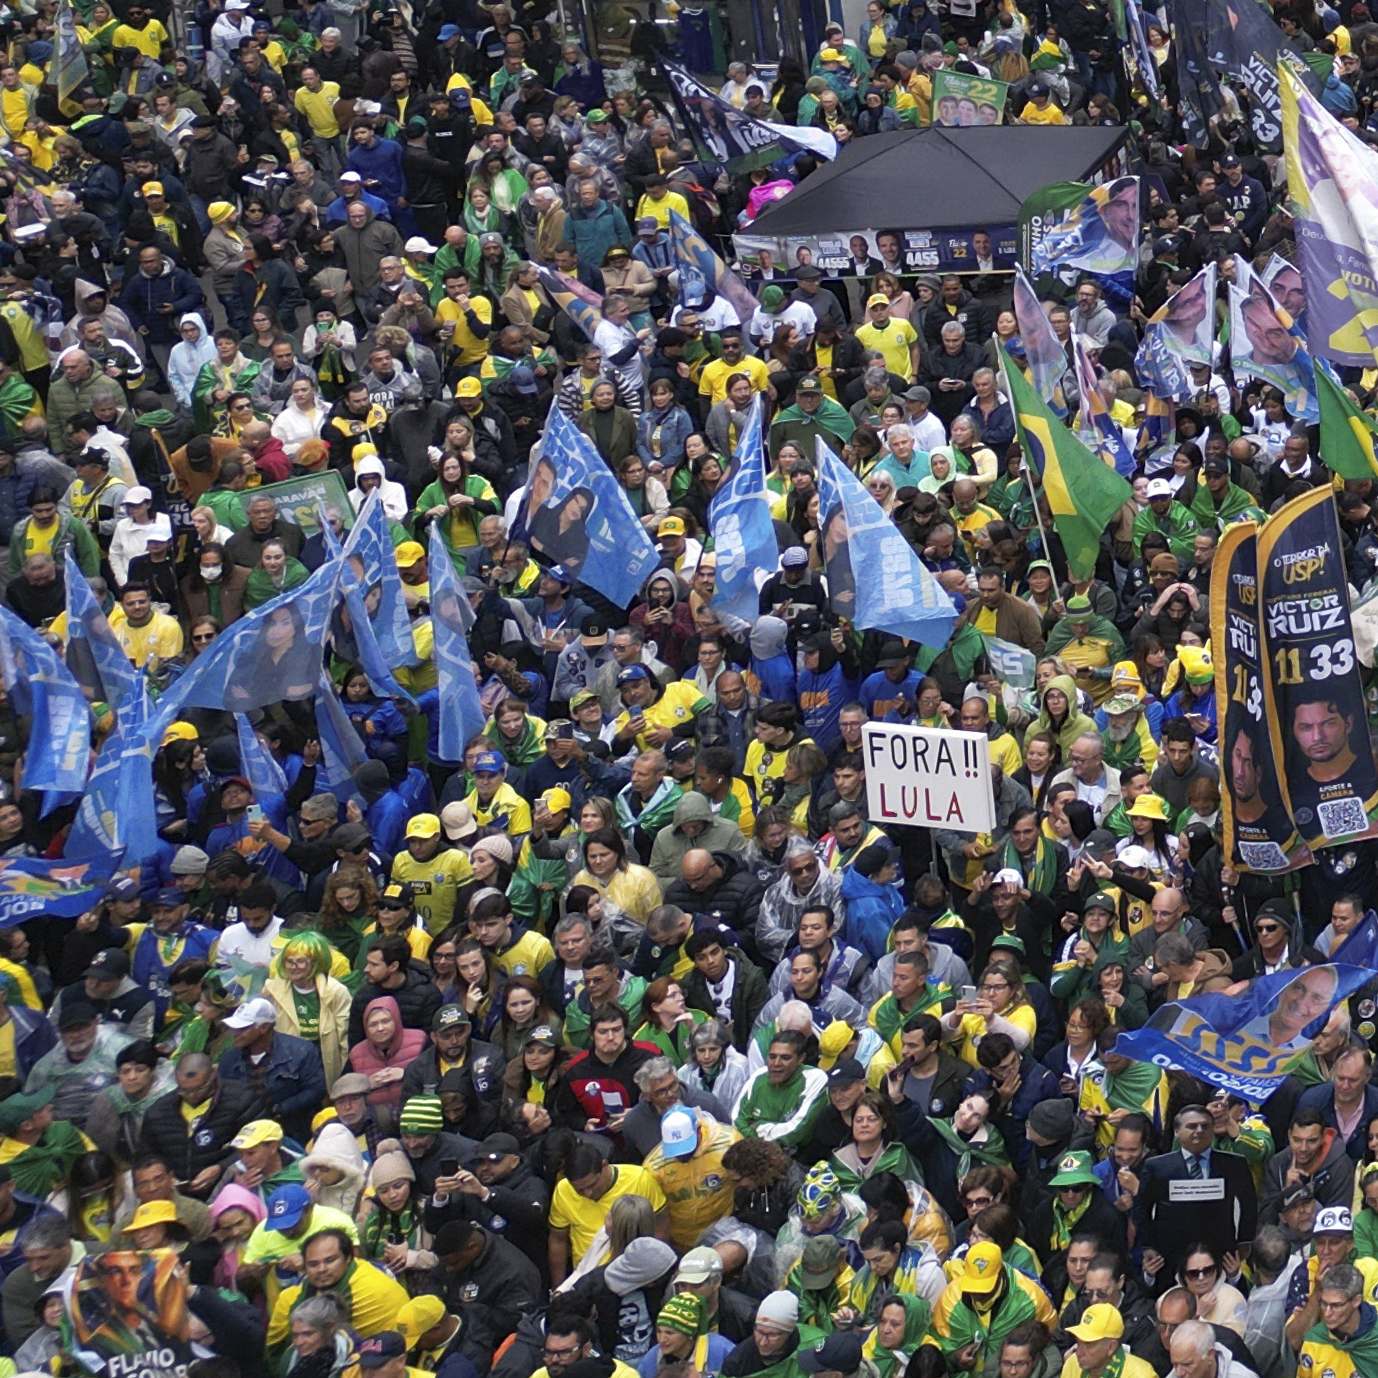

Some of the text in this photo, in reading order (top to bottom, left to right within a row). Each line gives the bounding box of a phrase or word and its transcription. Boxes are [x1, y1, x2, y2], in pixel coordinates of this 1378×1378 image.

[967, 81, 998, 101] 22
[906, 251, 939, 267] 4455
[1274, 559, 1281, 568] O
[1281, 549, 1316, 565] TERROR
[1282, 554, 1325, 585] USP!
[1268, 593, 1339, 617] VICTOR
[1268, 606, 1345, 638] RUIZ
[1230, 628, 1257, 660] RUI
[1275, 638, 1354, 685] 11 33
[868, 732, 978, 778] FORA!!
[880, 783, 964, 823] LULA
